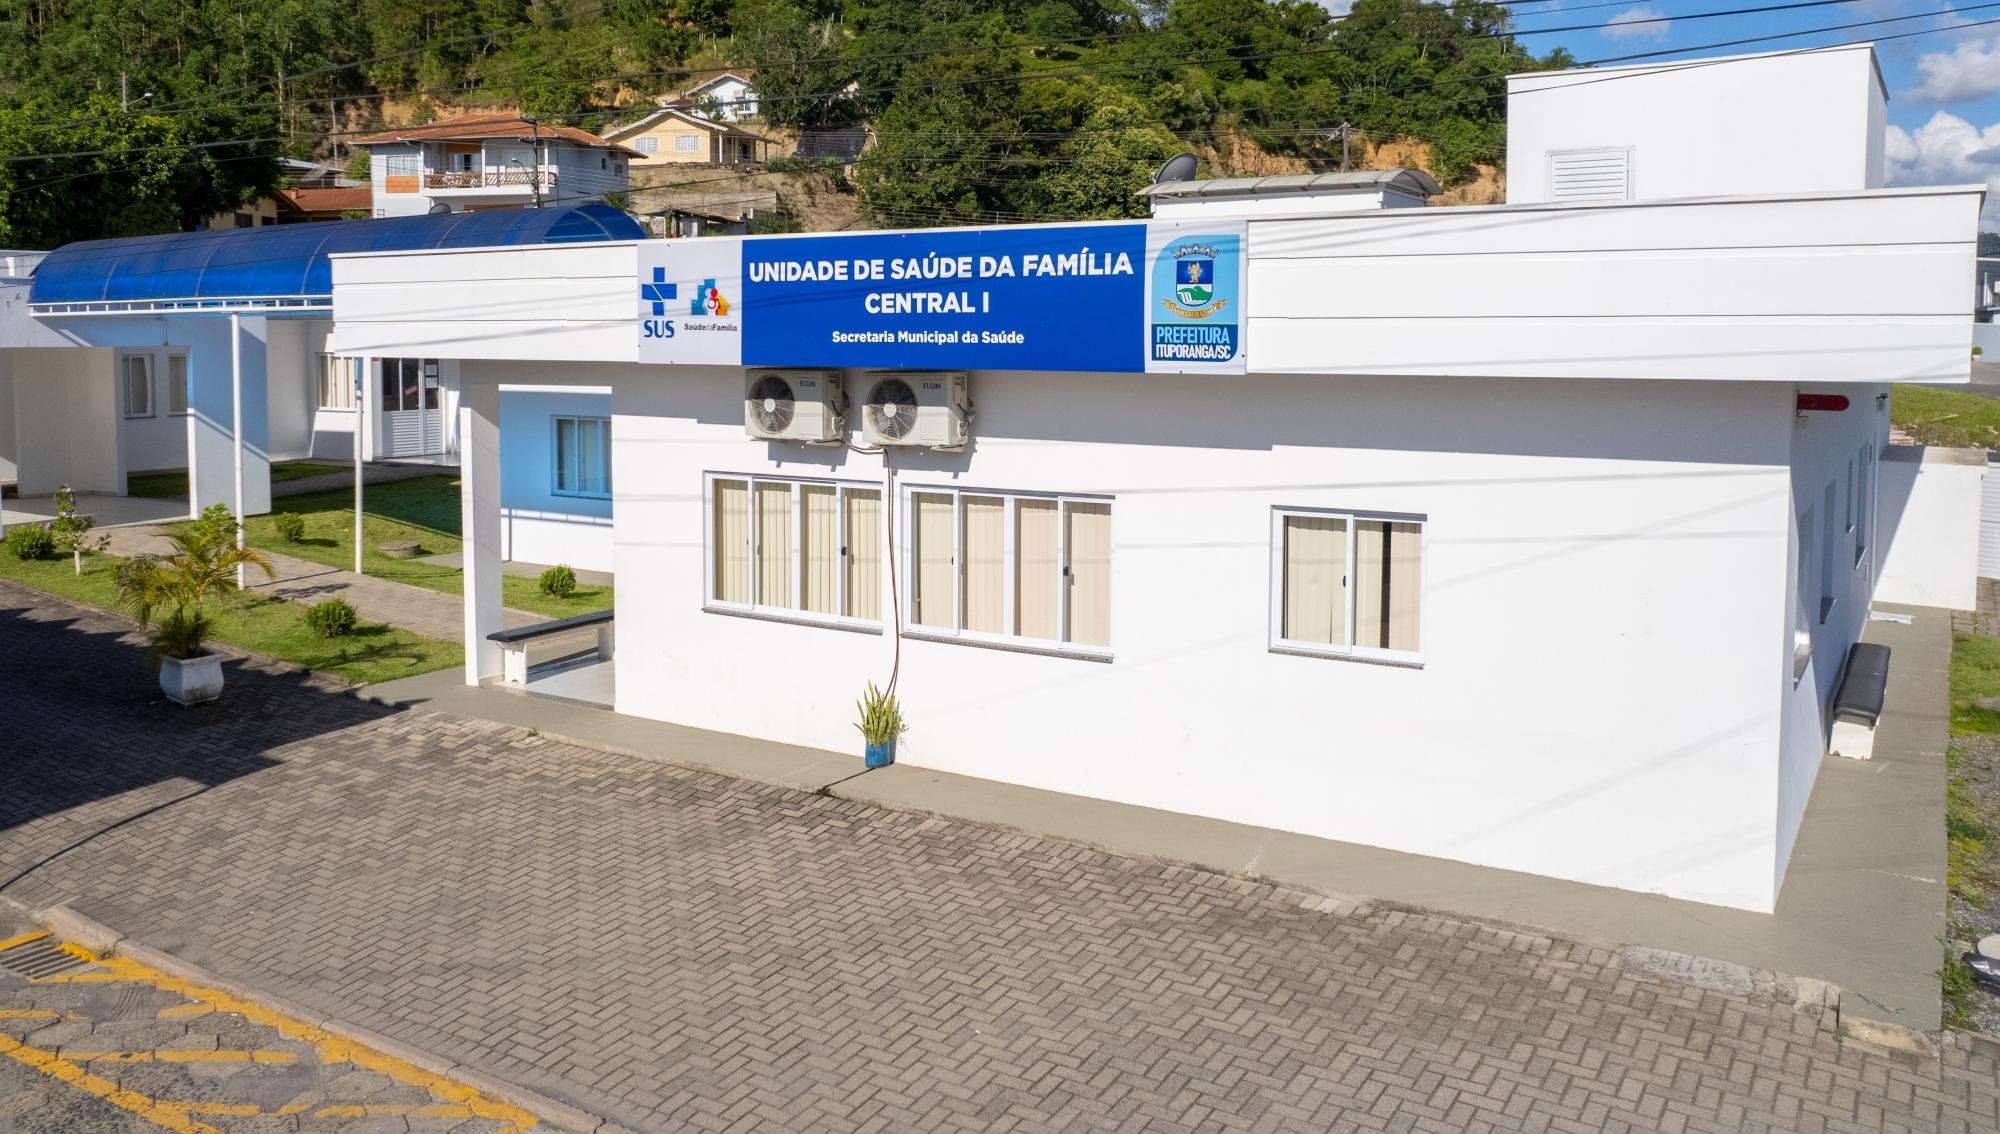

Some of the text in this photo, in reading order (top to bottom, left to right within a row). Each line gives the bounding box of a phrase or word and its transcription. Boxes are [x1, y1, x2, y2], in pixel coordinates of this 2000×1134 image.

[749, 247, 1134, 283] UNIDADE DE SAÚDE DA FAMÍLIA
[864, 291, 989, 314] CENTRAL I
[643, 320, 675, 339] SUS
[832, 330, 1025, 346] Secretaria Municipal da Saúde
[1156, 326, 1231, 344] PREFEITURA
[1155, 343, 1232, 360] ITUPORANGA/SC
[799, 380, 816, 388] ELGIN
[922, 382, 941, 390] ELGIN
